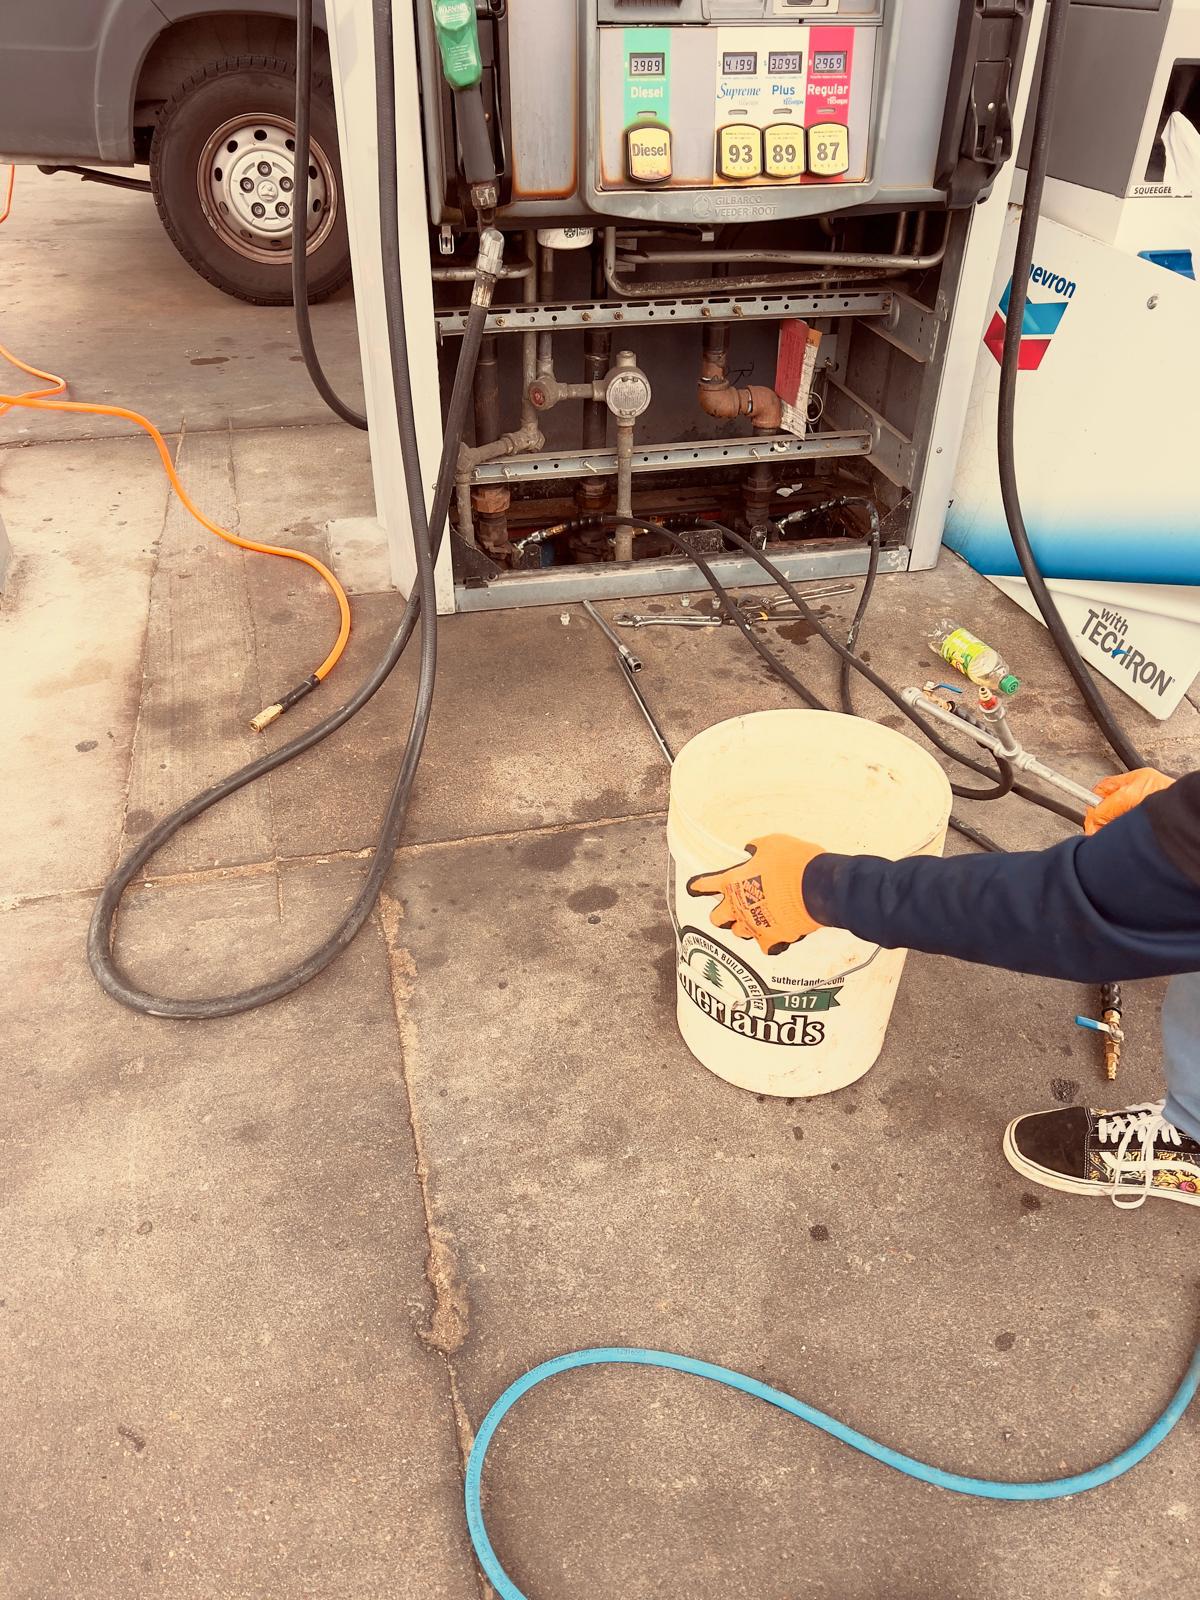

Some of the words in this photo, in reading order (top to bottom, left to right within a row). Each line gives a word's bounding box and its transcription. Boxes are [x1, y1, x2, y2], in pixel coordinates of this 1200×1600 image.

[633, 60, 660, 72] 3.989
[630, 86, 664, 98] Diesel
[716, 83, 760, 99] Supreme
[771, 84, 796, 96] Plus
[807, 83, 849, 98] Regular
[631, 142, 668, 157] Diesel
[728, 144, 754, 164] 93
[772, 144, 797, 163] 89
[816, 142, 841, 161] 87
[1133, 186, 1173, 195] SQUEEGEE
[715, 195, 762, 206] GILBARCO
[1030, 263, 1077, 299] evron
[1100, 608, 1129, 636] with
[1080, 608, 1173, 696] TECHRON
[692, 937, 719, 956] AMERICA
[720, 953, 744, 975] BUILD
[742, 974, 753, 983] IT
[678, 971, 825, 1046] erlands
[783, 995, 818, 1009] 1917
